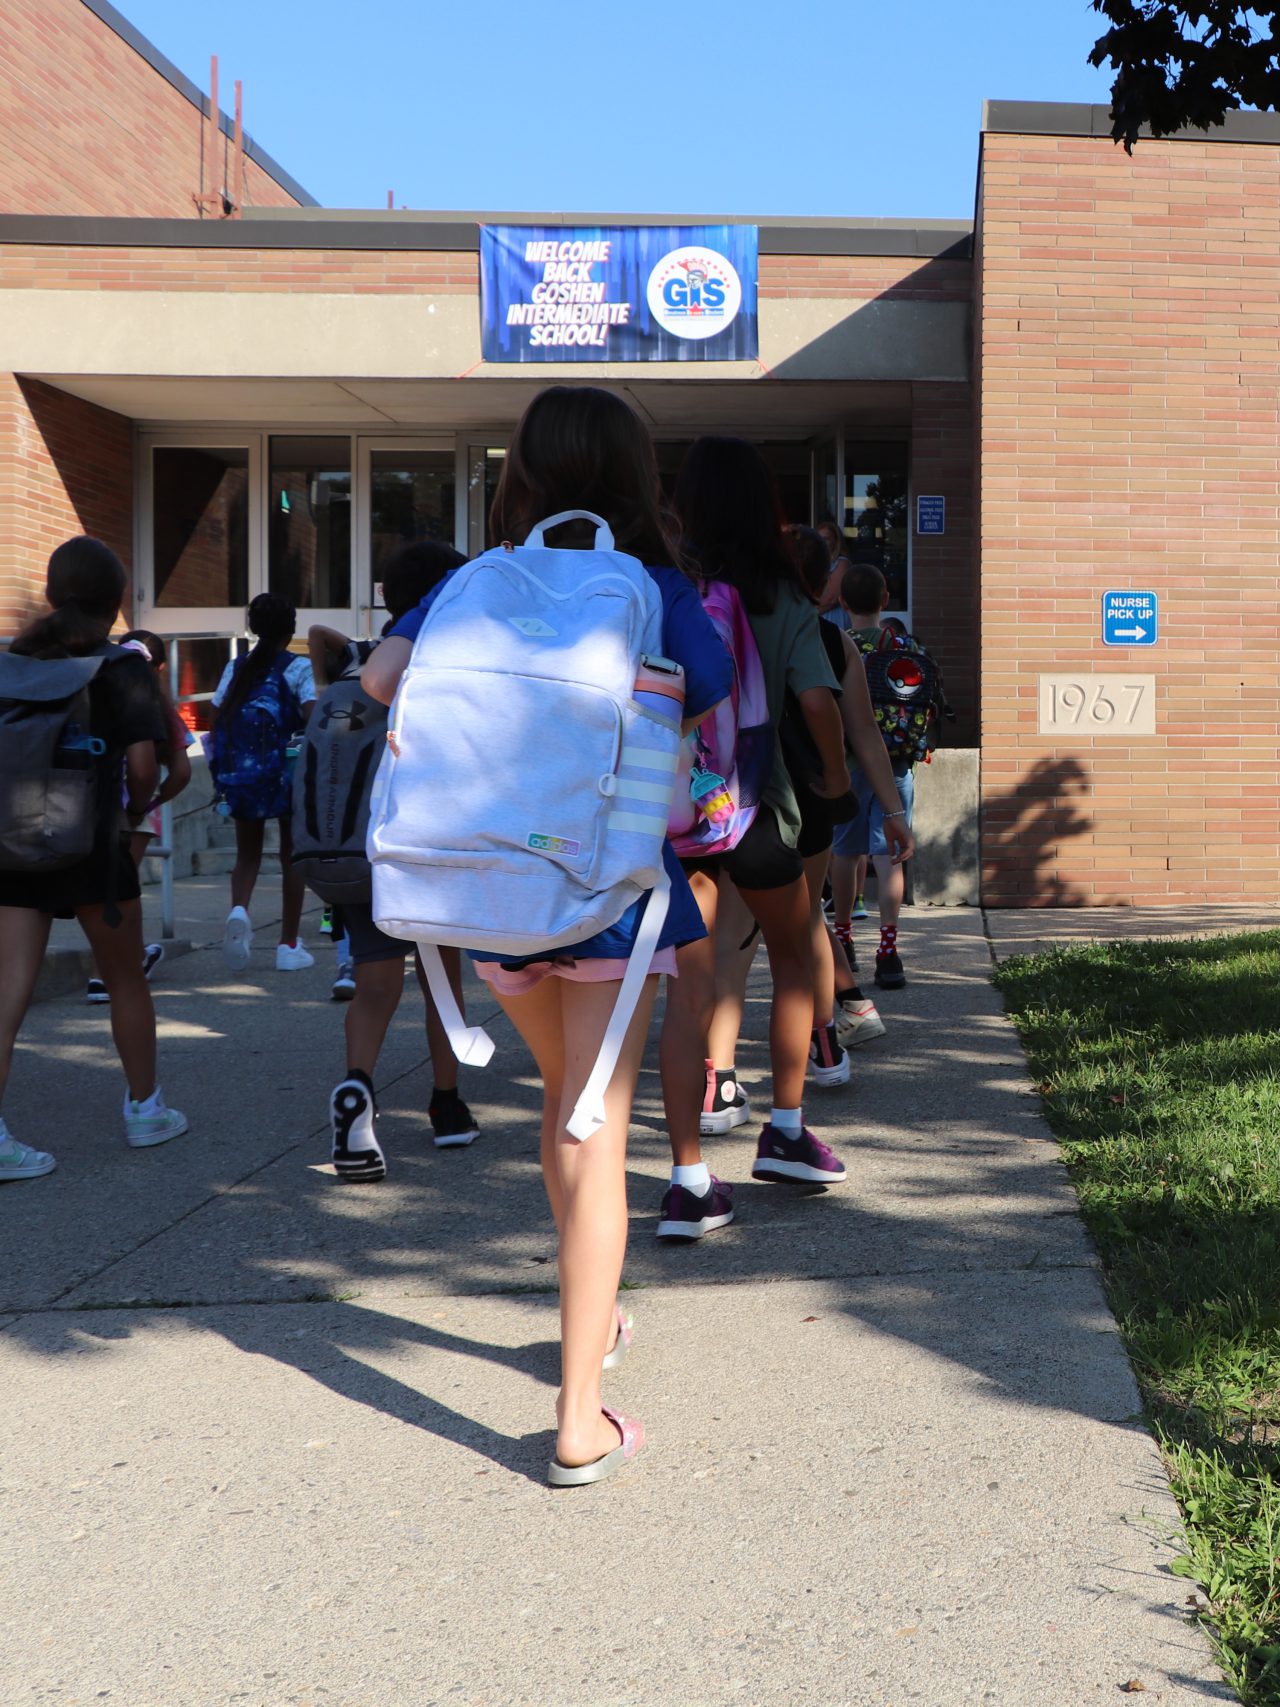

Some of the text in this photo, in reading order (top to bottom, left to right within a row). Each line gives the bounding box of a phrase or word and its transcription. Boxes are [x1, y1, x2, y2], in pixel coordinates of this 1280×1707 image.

[525, 241, 611, 262] WELCOME
[543, 262, 592, 282] BACK
[531, 282, 605, 304] GOSHEN
[506, 303, 630, 325] INTERMEDIATE
[529, 324, 609, 346] SCHOOL!
[1110, 597, 1150, 608] NURSE
[1107, 609, 1154, 620] PICK UP
[1048, 683, 1145, 725] 1967
[530, 838, 577, 855] adidas
